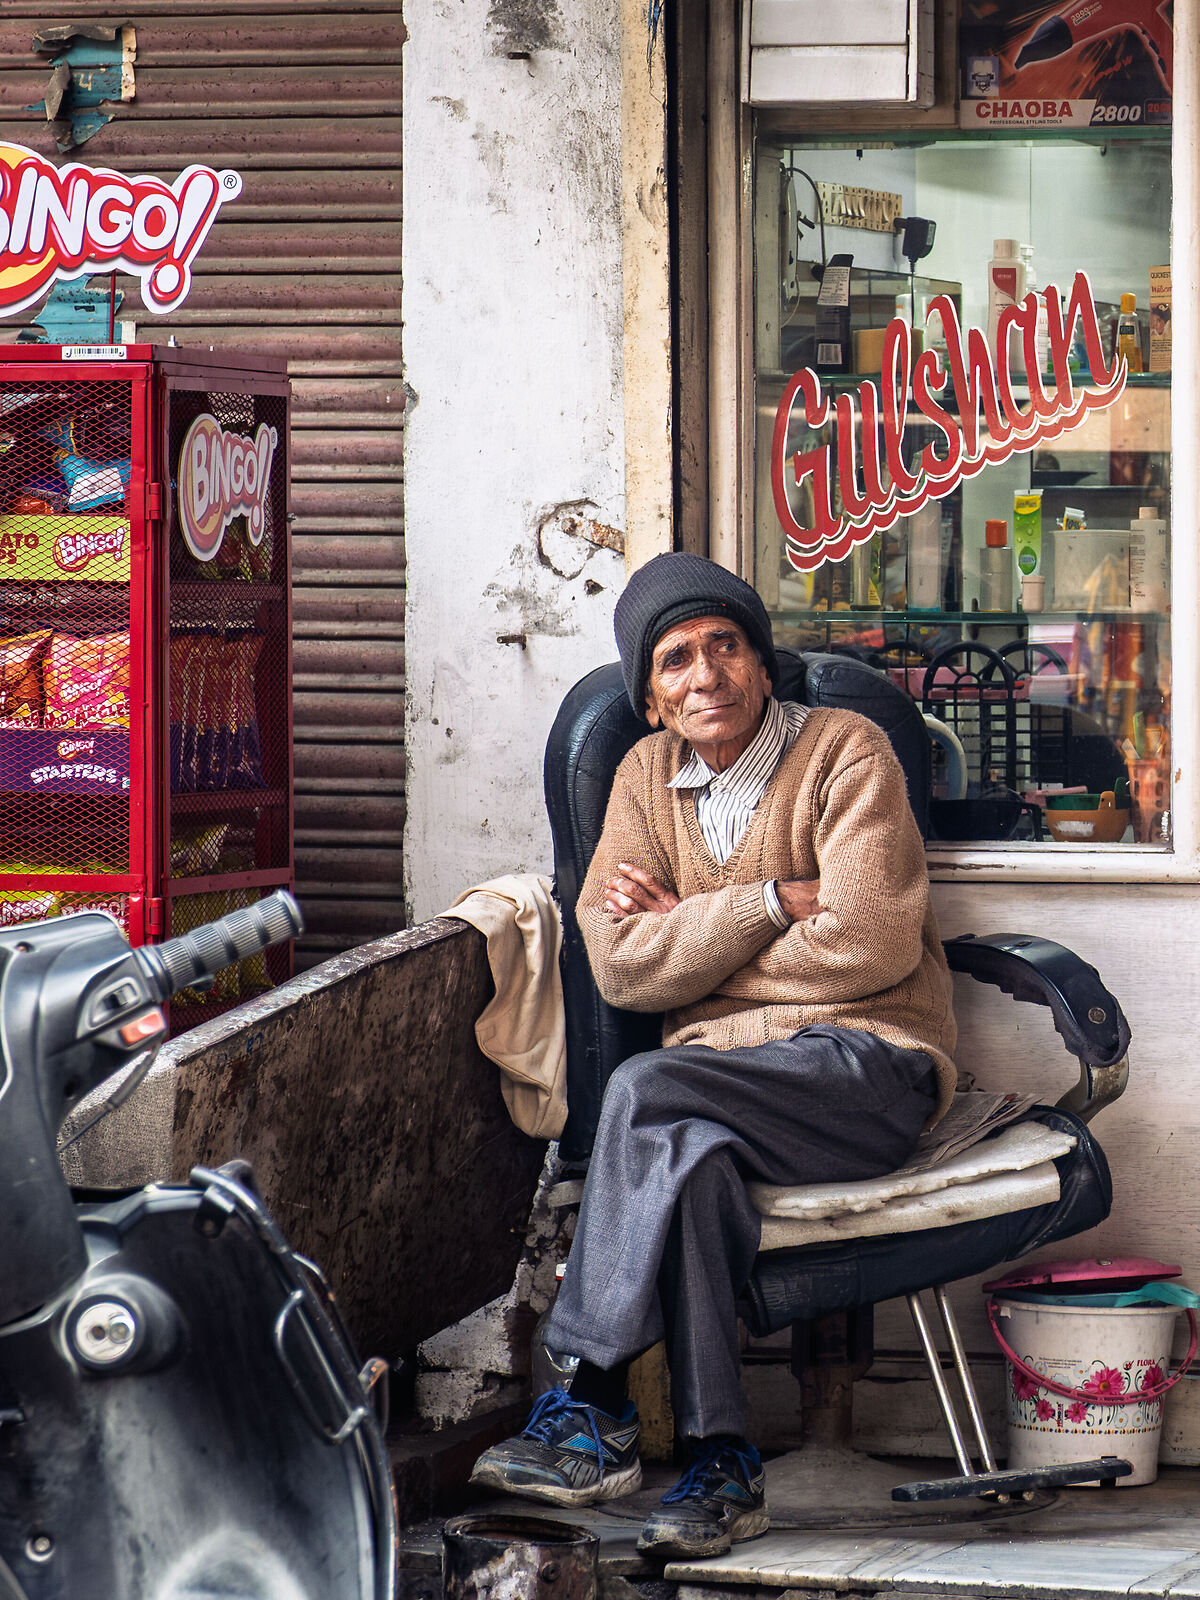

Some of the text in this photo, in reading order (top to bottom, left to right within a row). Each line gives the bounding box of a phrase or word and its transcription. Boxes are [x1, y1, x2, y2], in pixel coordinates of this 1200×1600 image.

[975, 101, 1142, 123] CHAOBA 2800
[0, 165, 215, 293] INGO!
[771, 270, 1130, 558] Gulshan
[192, 432, 269, 528] BINGO!
[0, 532, 39, 548] ATO
[58, 526, 126, 565] BINGO!
[60, 738, 95, 756] BINGO!
[30, 763, 118, 784] STARTERS
[1136, 1358, 1156, 1367] FLORA
